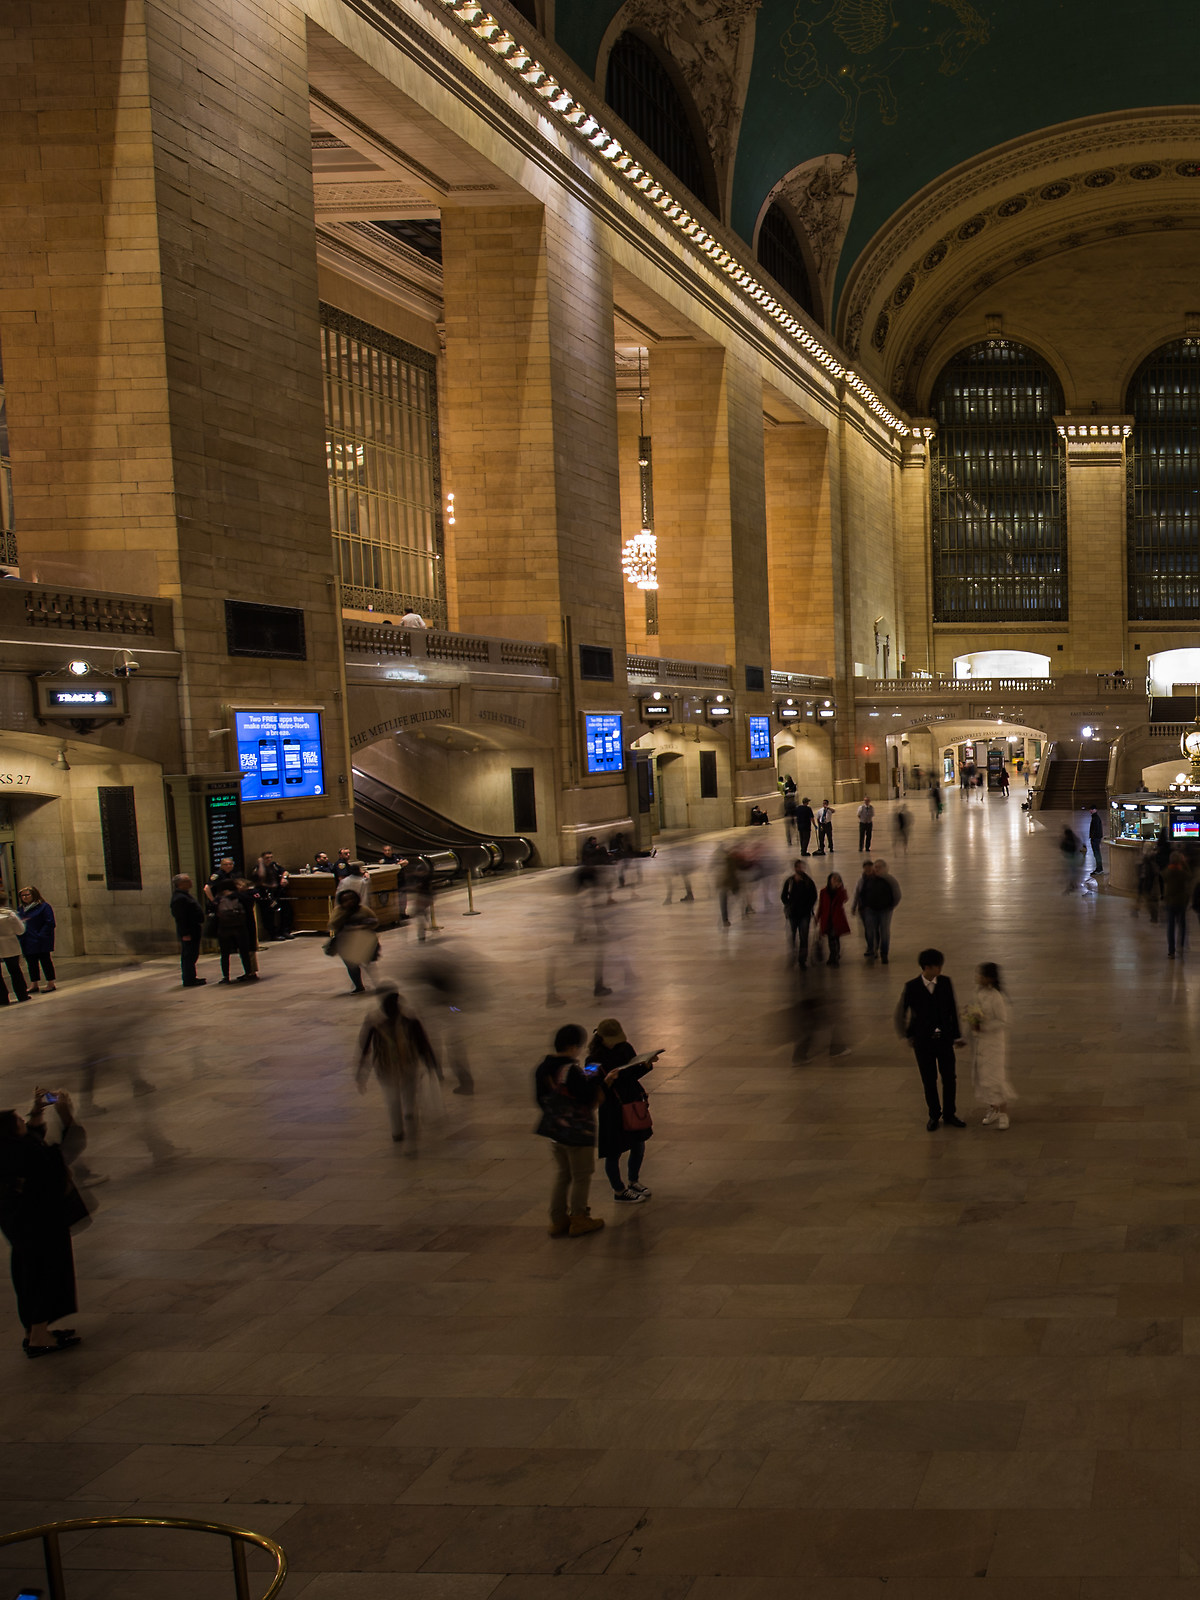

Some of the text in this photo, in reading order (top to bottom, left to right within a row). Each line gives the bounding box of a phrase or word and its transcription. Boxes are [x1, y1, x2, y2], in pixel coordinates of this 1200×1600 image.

[368, 714, 409, 736] METLIFE
[410, 708, 451, 724] BUILDING
[479, 710, 526, 728] 45TH STREET
[17, 774, 31, 785] 27
